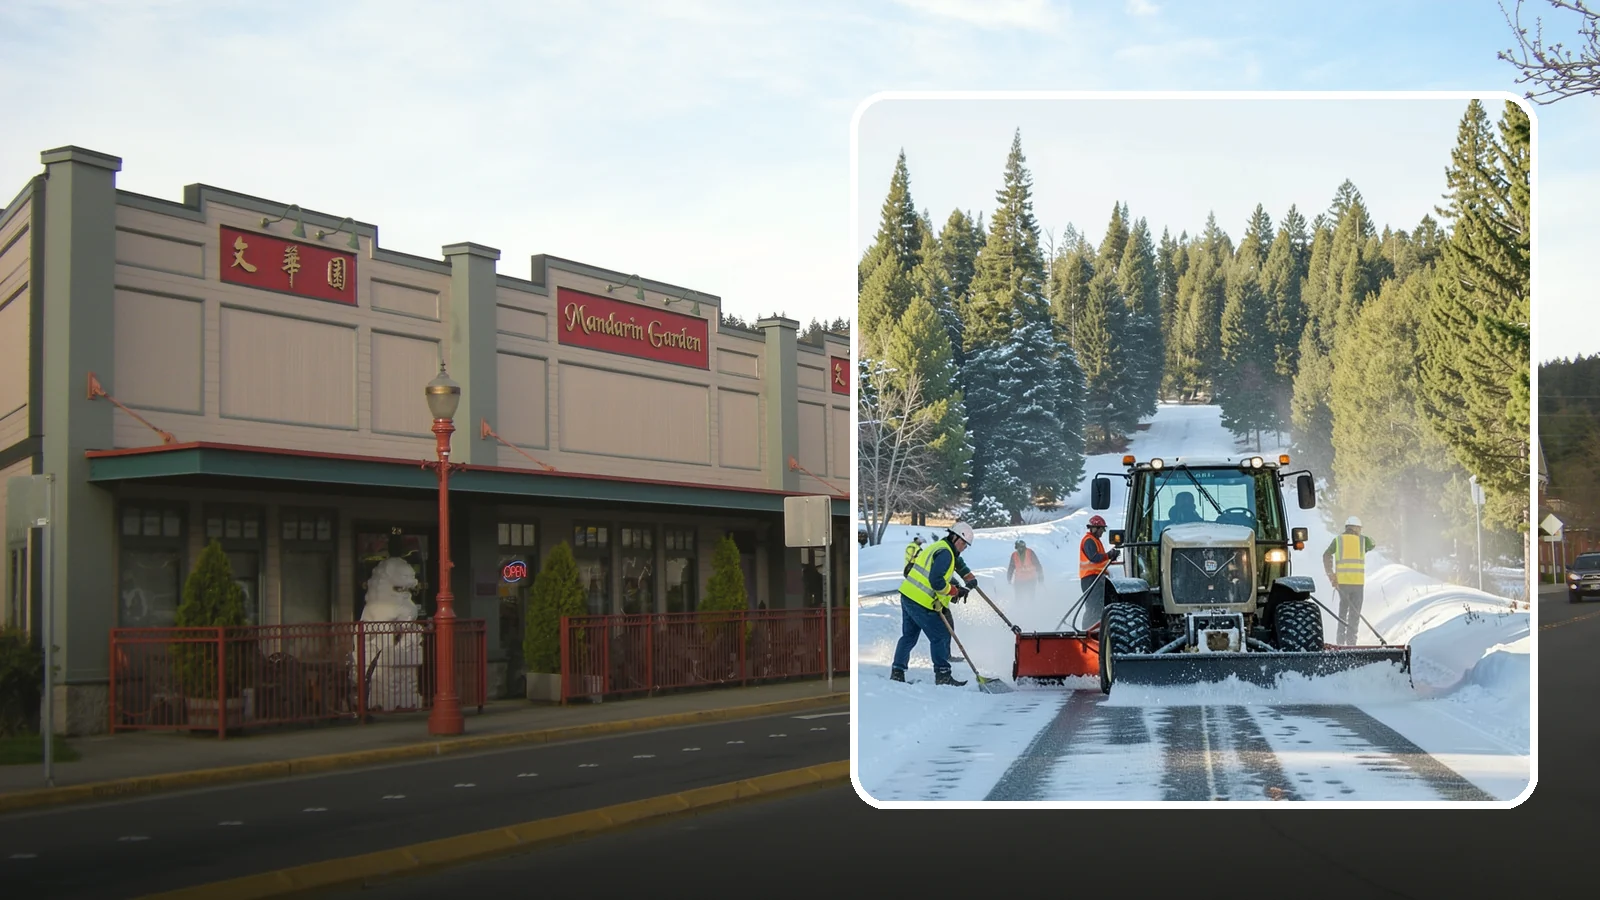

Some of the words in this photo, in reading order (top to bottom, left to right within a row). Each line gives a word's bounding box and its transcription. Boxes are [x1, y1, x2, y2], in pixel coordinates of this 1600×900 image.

[230, 236, 346, 291] 文華園
[564, 302, 644, 341] Mandarin
[648, 320, 701, 352] Garden
[503, 565, 526, 578] OPEN
